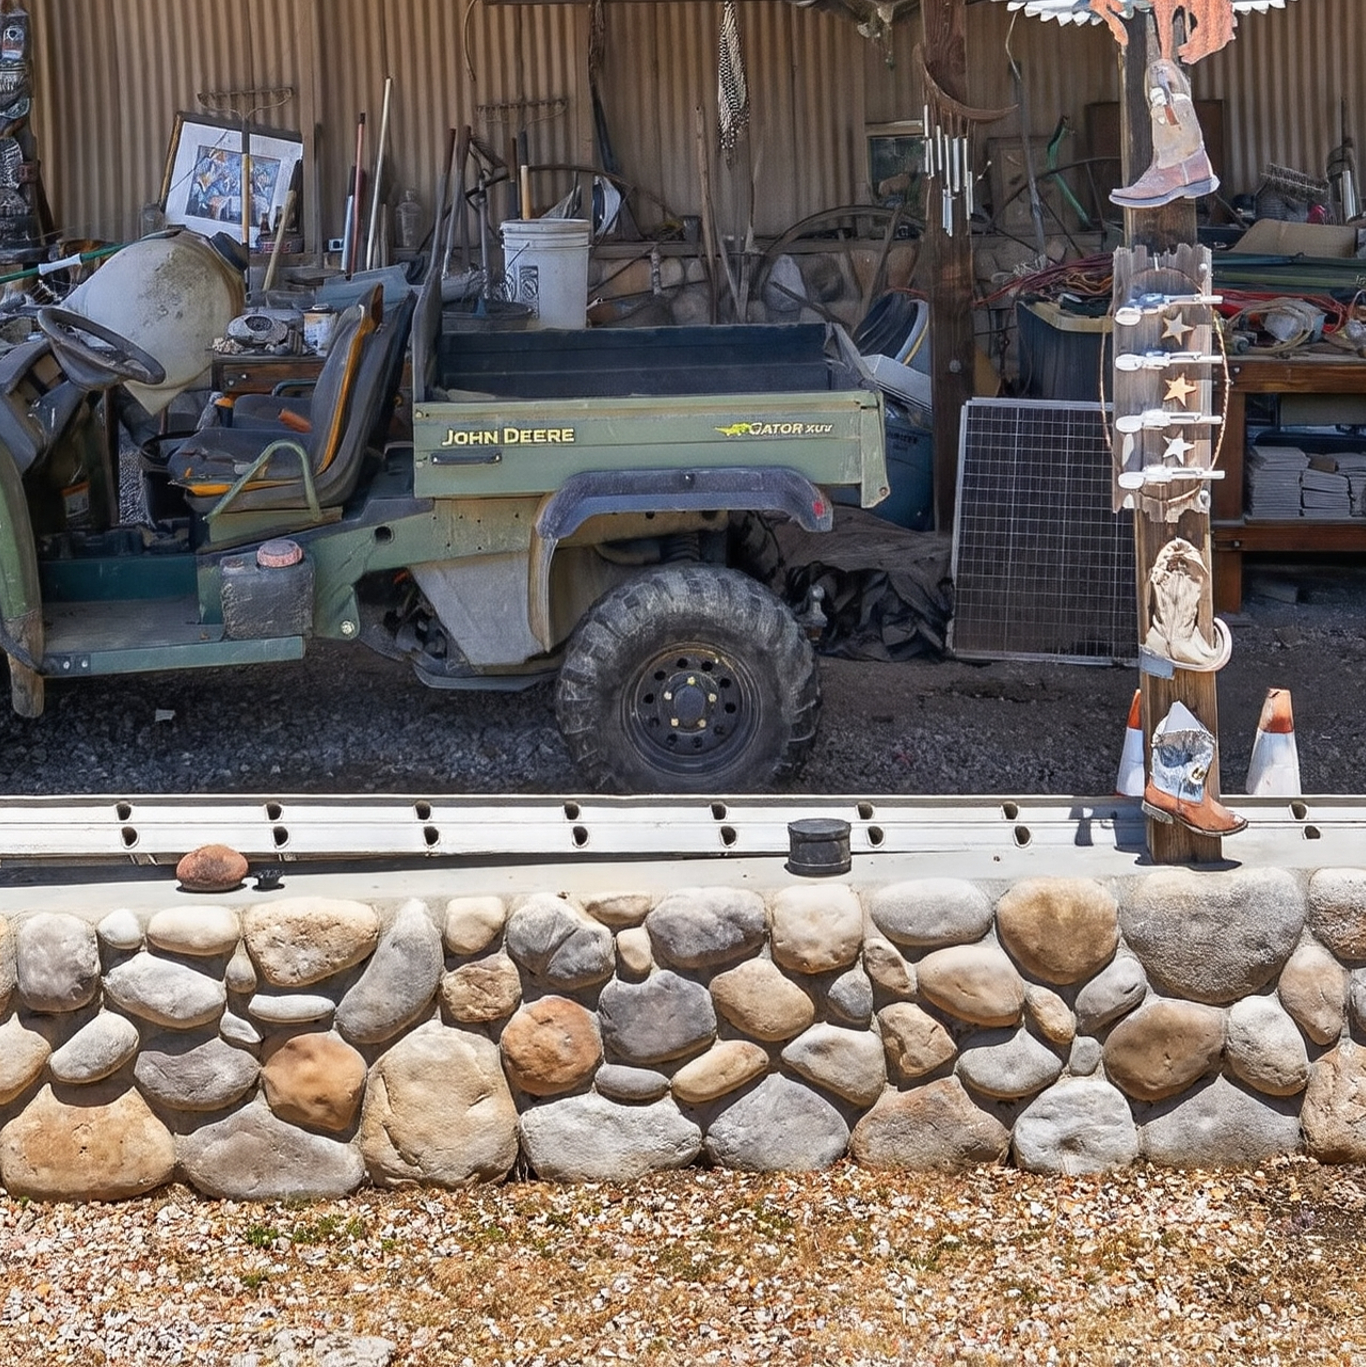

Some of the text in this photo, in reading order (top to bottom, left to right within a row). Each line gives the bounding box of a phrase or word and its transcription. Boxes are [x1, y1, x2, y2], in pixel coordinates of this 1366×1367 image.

[441, 427, 576, 446] JOHN DEERE
[748, 422, 804, 435] GATOR
